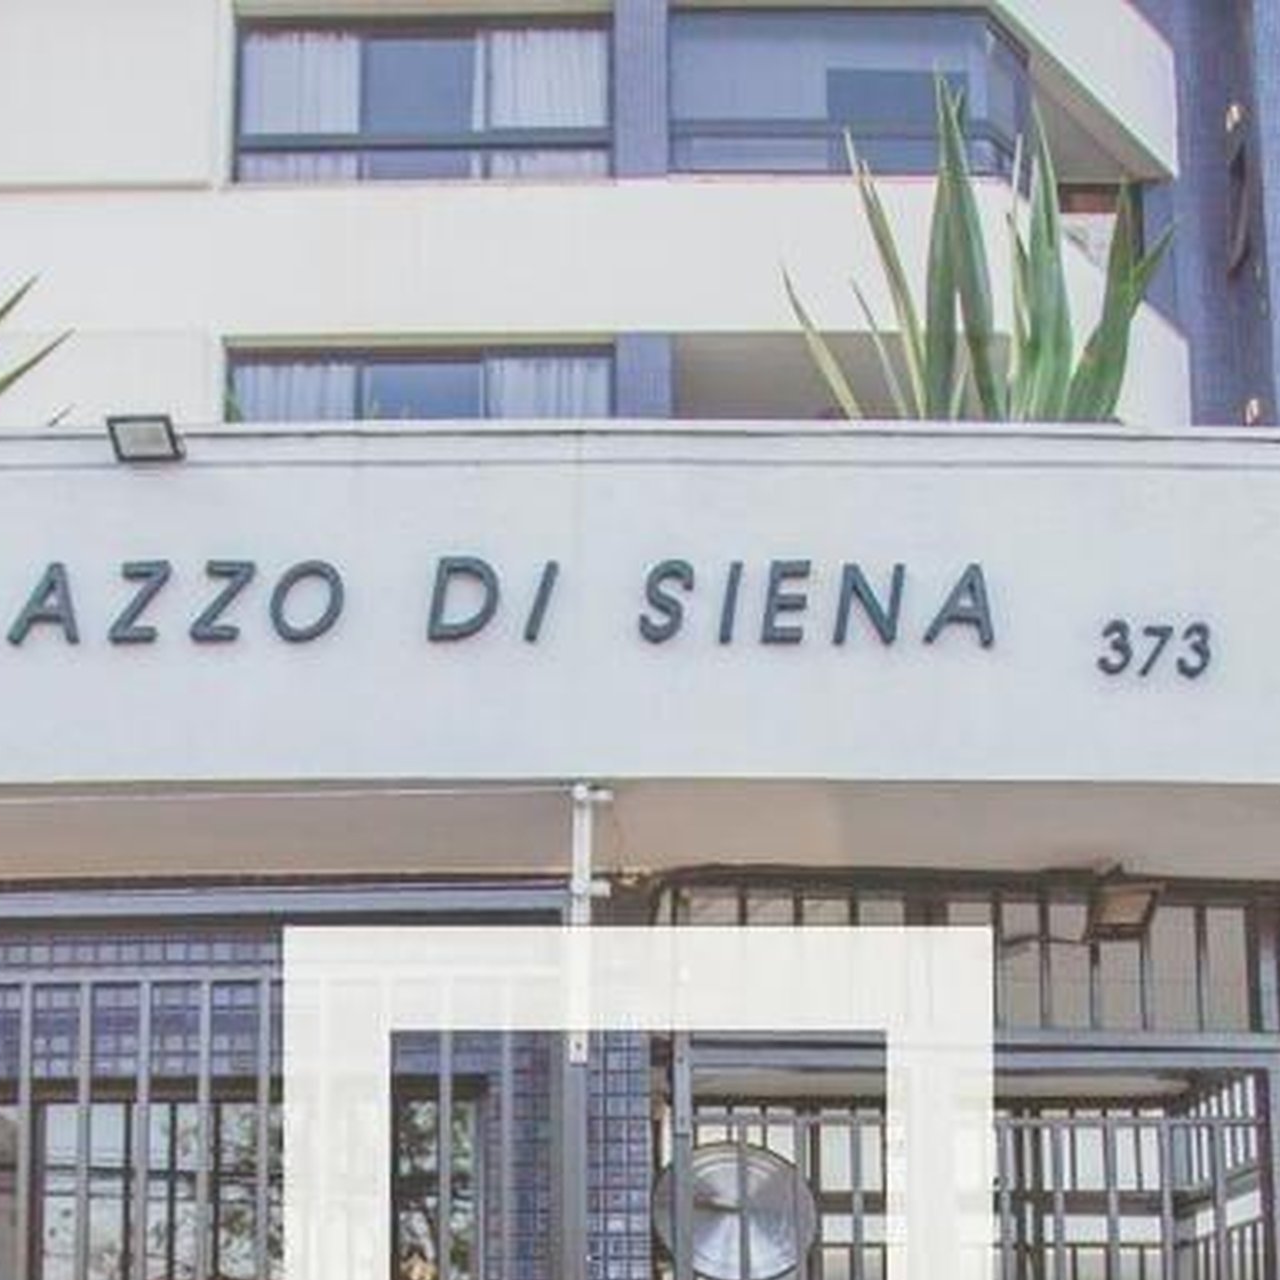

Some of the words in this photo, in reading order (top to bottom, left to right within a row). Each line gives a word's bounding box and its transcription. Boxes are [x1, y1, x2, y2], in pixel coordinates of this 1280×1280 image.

[425, 555, 560, 646] DI
[637, 558, 996, 652] SIENA
[1095, 618, 1212, 682] 373
